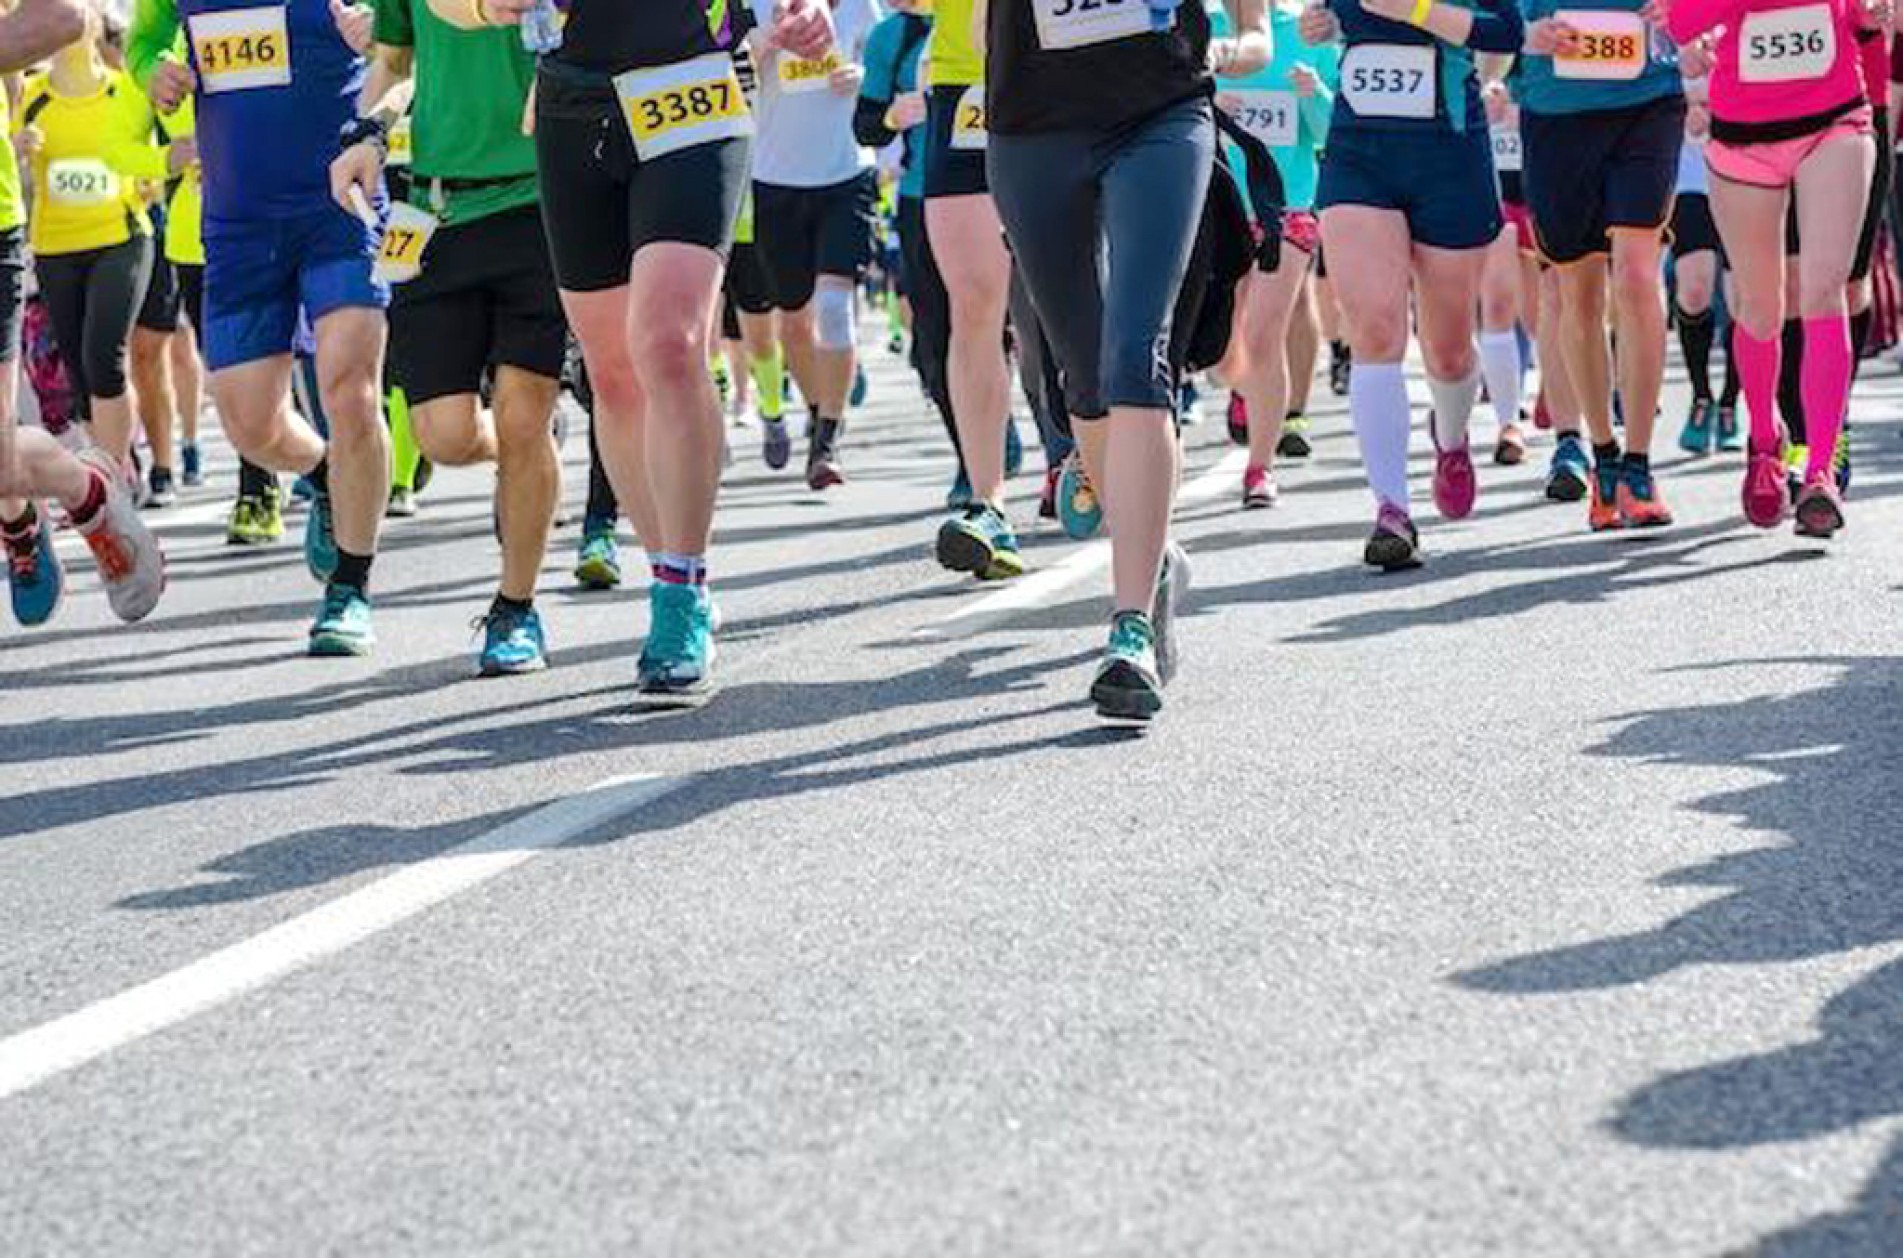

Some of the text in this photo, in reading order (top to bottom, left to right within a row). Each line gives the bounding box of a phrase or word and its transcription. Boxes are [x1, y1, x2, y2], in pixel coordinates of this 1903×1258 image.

[203, 34, 275, 68] 4146
[1569, 34, 1633, 58] 388
[1751, 29, 1824, 59] 5536
[1352, 68, 1423, 93] 5537
[641, 83, 729, 130] 3387
[56, 171, 107, 192] 5021
